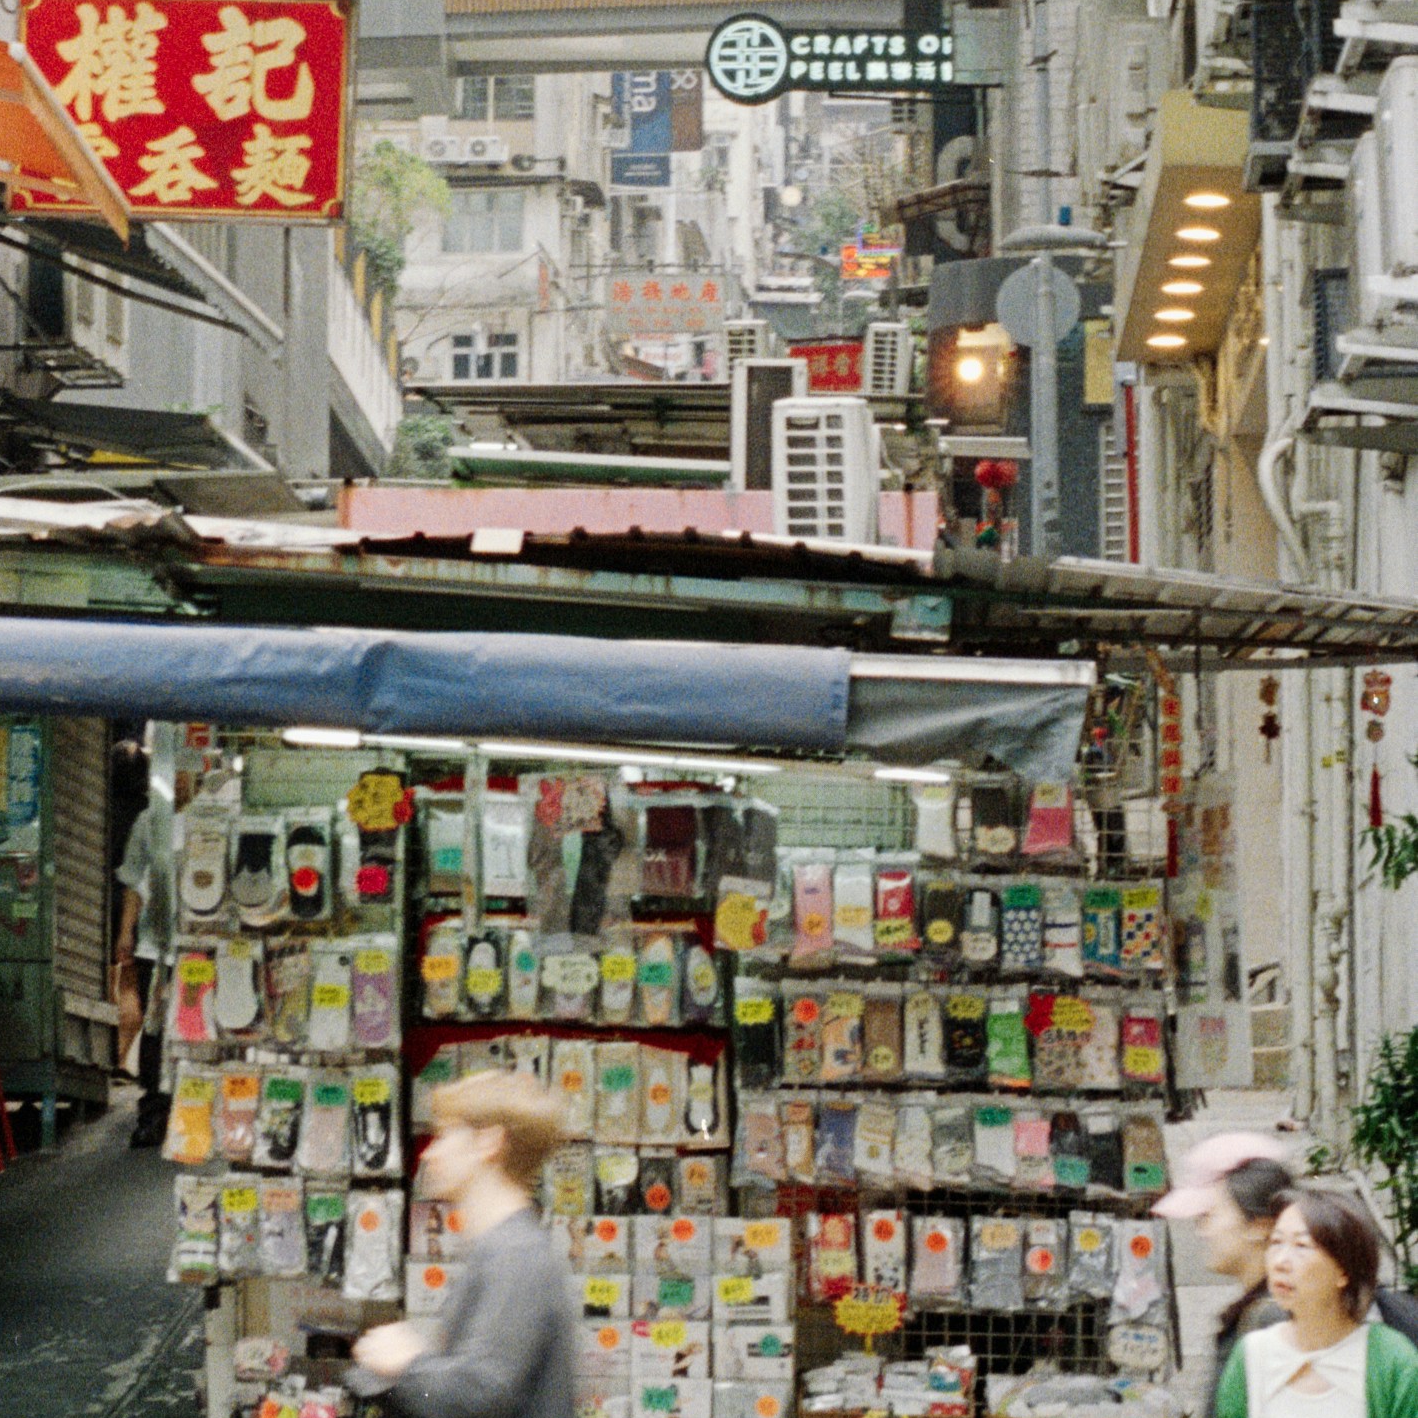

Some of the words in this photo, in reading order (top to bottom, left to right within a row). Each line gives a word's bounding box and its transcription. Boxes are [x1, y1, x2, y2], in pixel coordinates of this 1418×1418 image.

[52, 1, 316, 123] 權記
[789, 34, 906, 57] CRAFTS
[789, 60, 862, 81] PEEL
[77, 122, 316, 207] 吞麵
